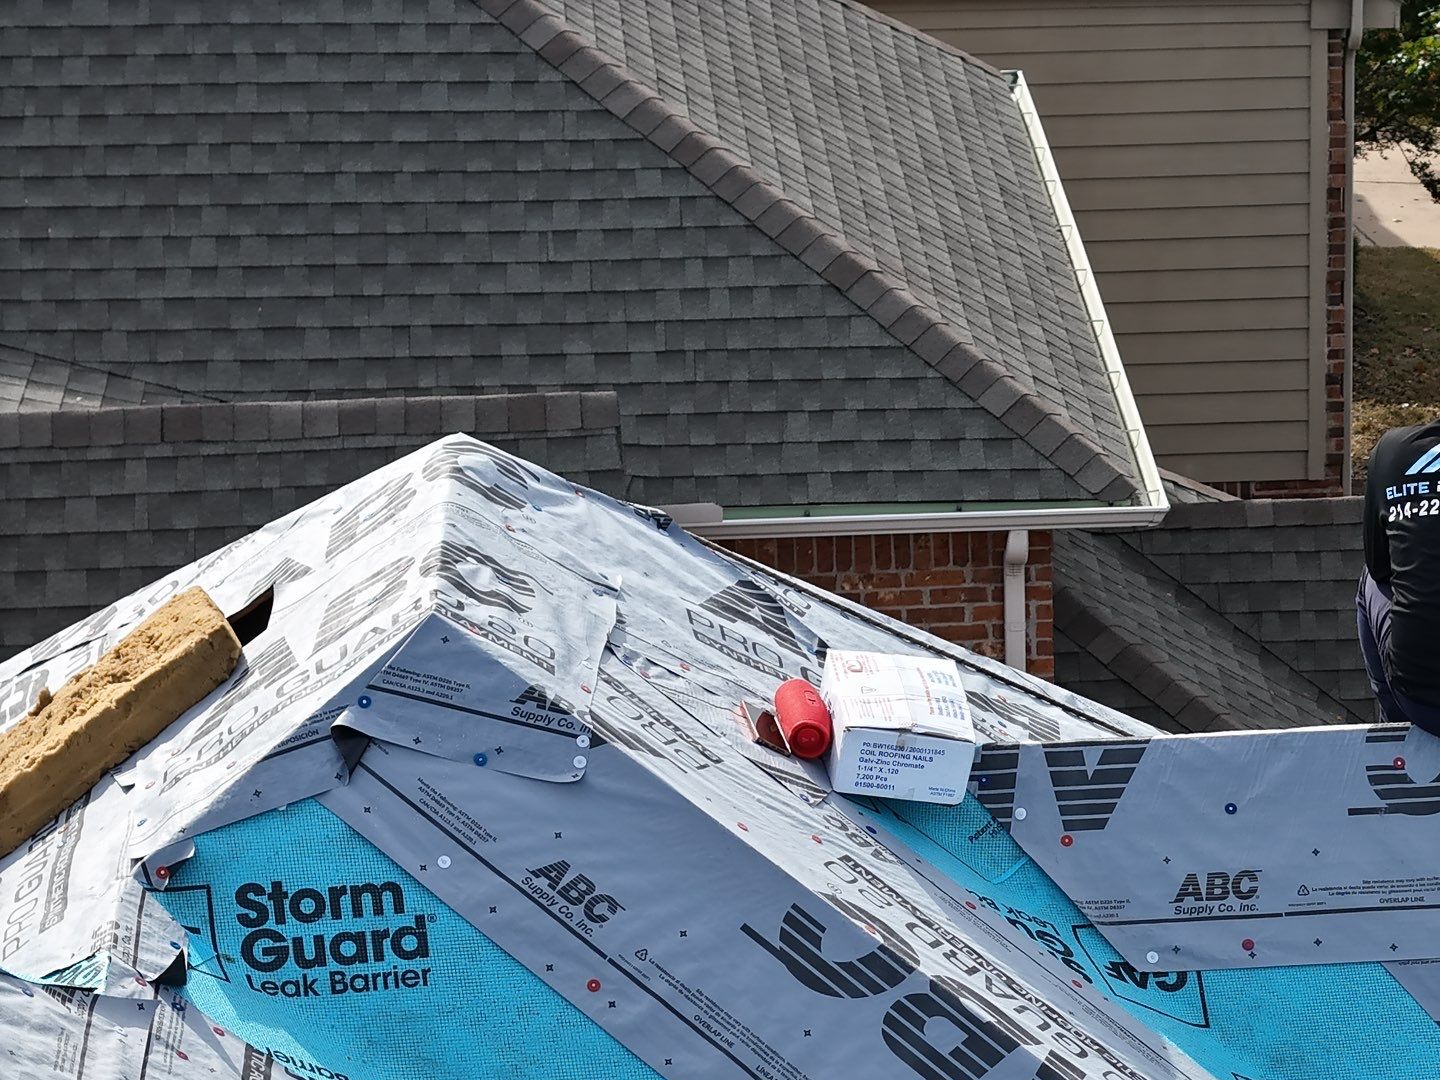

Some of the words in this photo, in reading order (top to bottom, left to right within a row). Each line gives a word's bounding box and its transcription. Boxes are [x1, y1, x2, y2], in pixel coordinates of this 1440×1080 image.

[1386, 482, 1430, 500] ELITE
[860, 749, 876, 757] COIL
[878, 750, 911, 760] ROOFING
[892, 760, 925, 769] Chromate
[521, 876, 557, 908] Supply
[558, 905, 574, 923] Co.
[525, 859, 626, 924] ABC
[1168, 870, 1262, 904] ABC
[1379, 896, 1410, 904] OVERLAP
[234, 880, 406, 928] Storm
[1174, 903, 1215, 916] Supply
[240, 914, 430, 972] Guard
[245, 973, 321, 998] Leak
[329, 965, 432, 995] Barrier
[693, 1013, 722, 1038] OVERLAP
[720, 1034, 736, 1049] LINE
